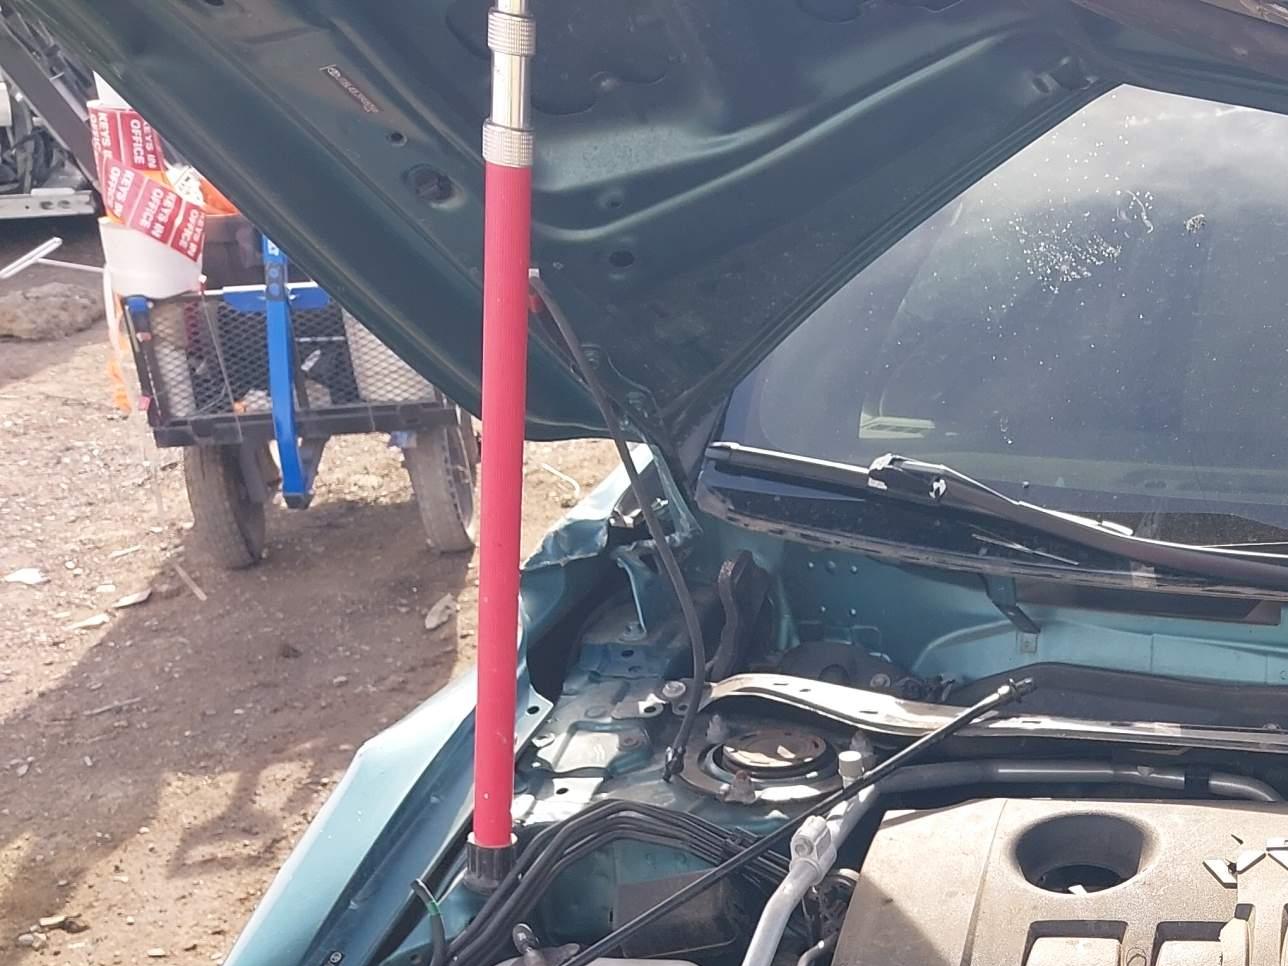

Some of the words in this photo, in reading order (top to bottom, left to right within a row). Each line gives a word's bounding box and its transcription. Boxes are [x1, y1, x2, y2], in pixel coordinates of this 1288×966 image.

[131, 119, 145, 165] OFFICE
[147, 154, 157, 168] IN
[116, 170, 135, 202] KEYS
[140, 188, 164, 229] OFFICE
[157, 191, 177, 224] KEYS
[151, 222, 165, 238] IN
[179, 209, 199, 249] OFFICE
[187, 242, 198, 257] IN
